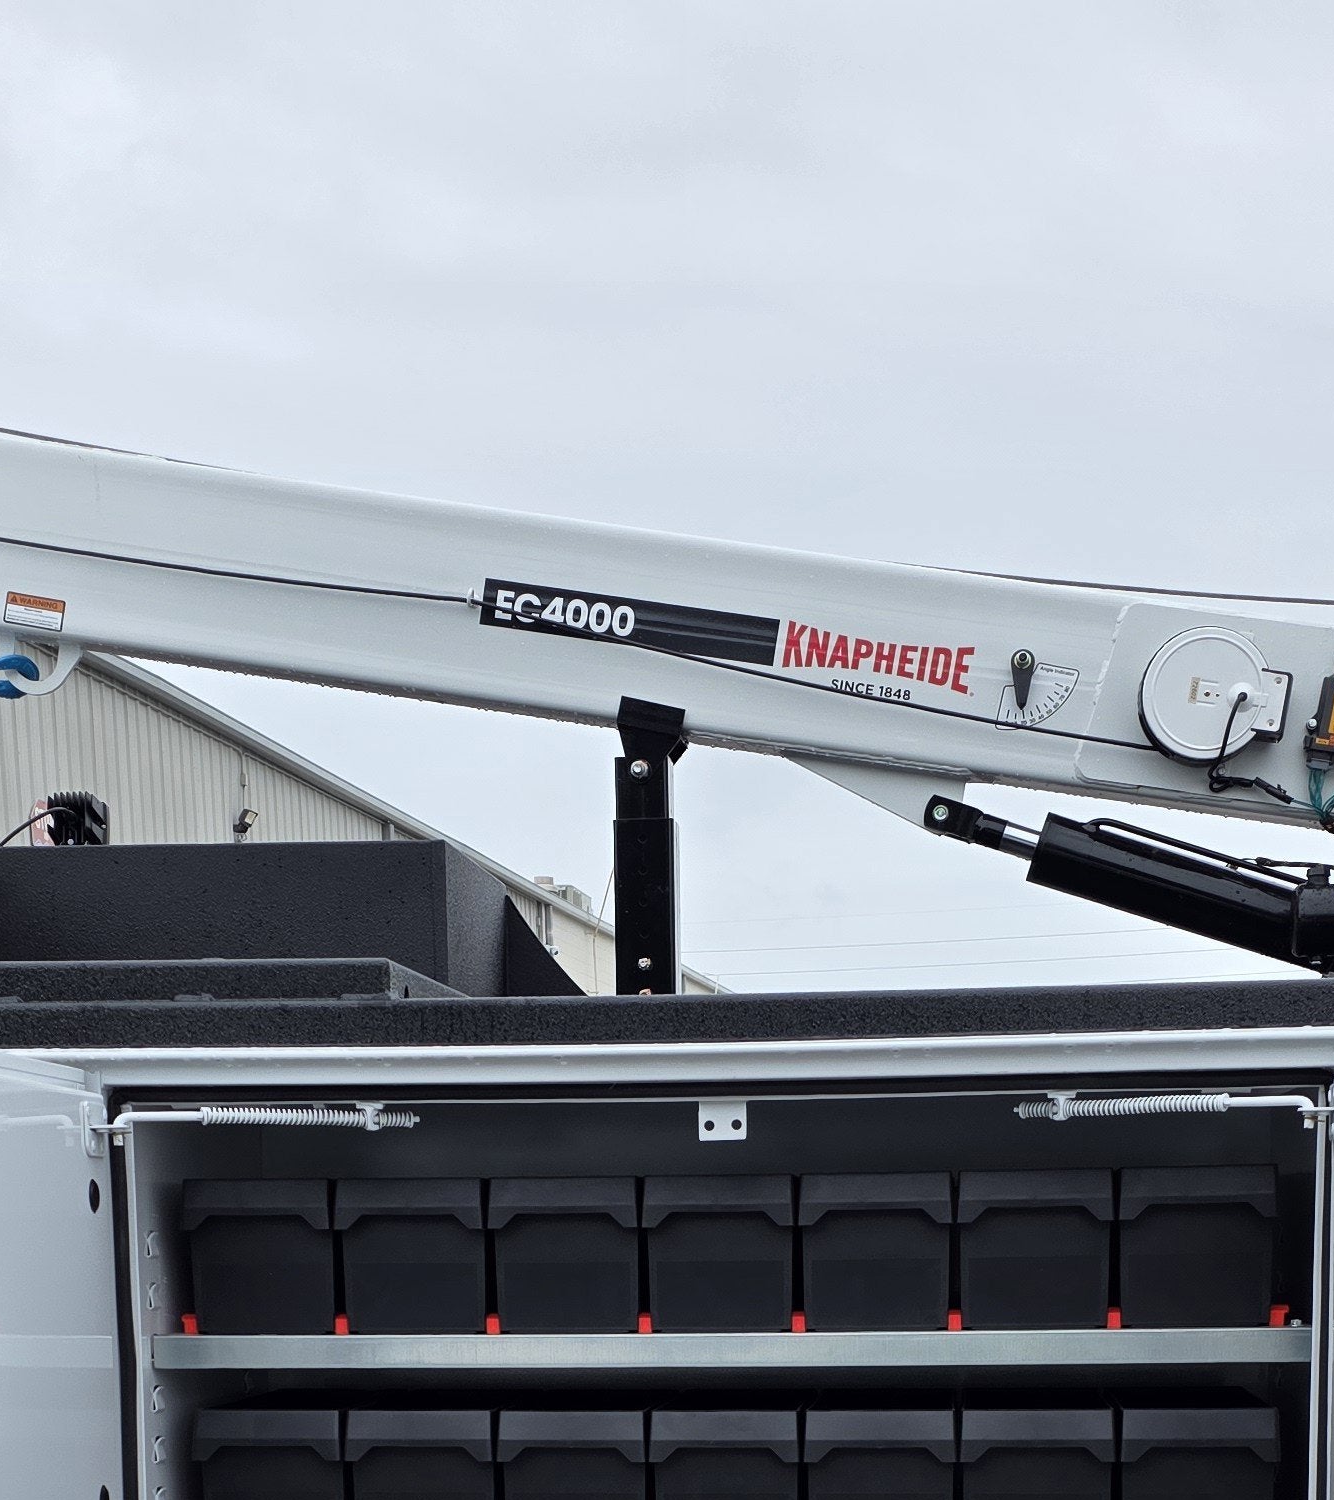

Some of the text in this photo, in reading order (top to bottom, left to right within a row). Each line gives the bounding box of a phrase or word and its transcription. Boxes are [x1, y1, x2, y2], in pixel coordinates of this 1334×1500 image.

[19, 597, 58, 609] WARNING
[494, 589, 635, 637] EC4000
[781, 620, 976, 695] KNAPHEIDE
[830, 678, 911, 701] SINCE 1848
